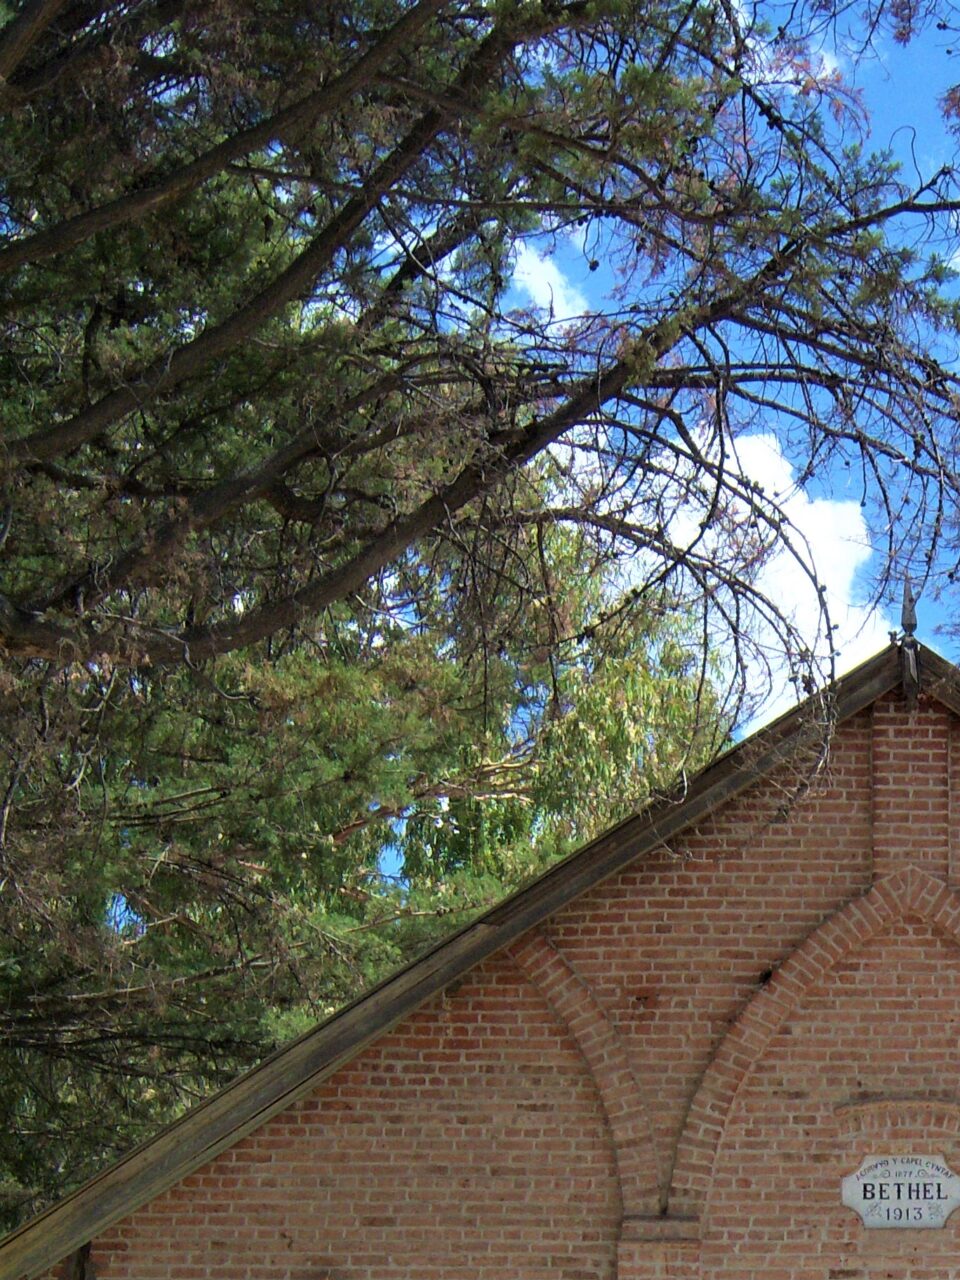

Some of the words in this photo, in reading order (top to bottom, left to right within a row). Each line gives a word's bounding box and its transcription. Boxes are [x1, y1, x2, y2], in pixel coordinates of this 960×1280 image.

[892, 1157, 898, 1165] Y
[901, 1157, 923, 1167] CAPEL
[925, 1161, 955, 1180] CYNTAF
[862, 1182, 949, 1201] BETHEL
[886, 1207, 923, 1221] 1913
